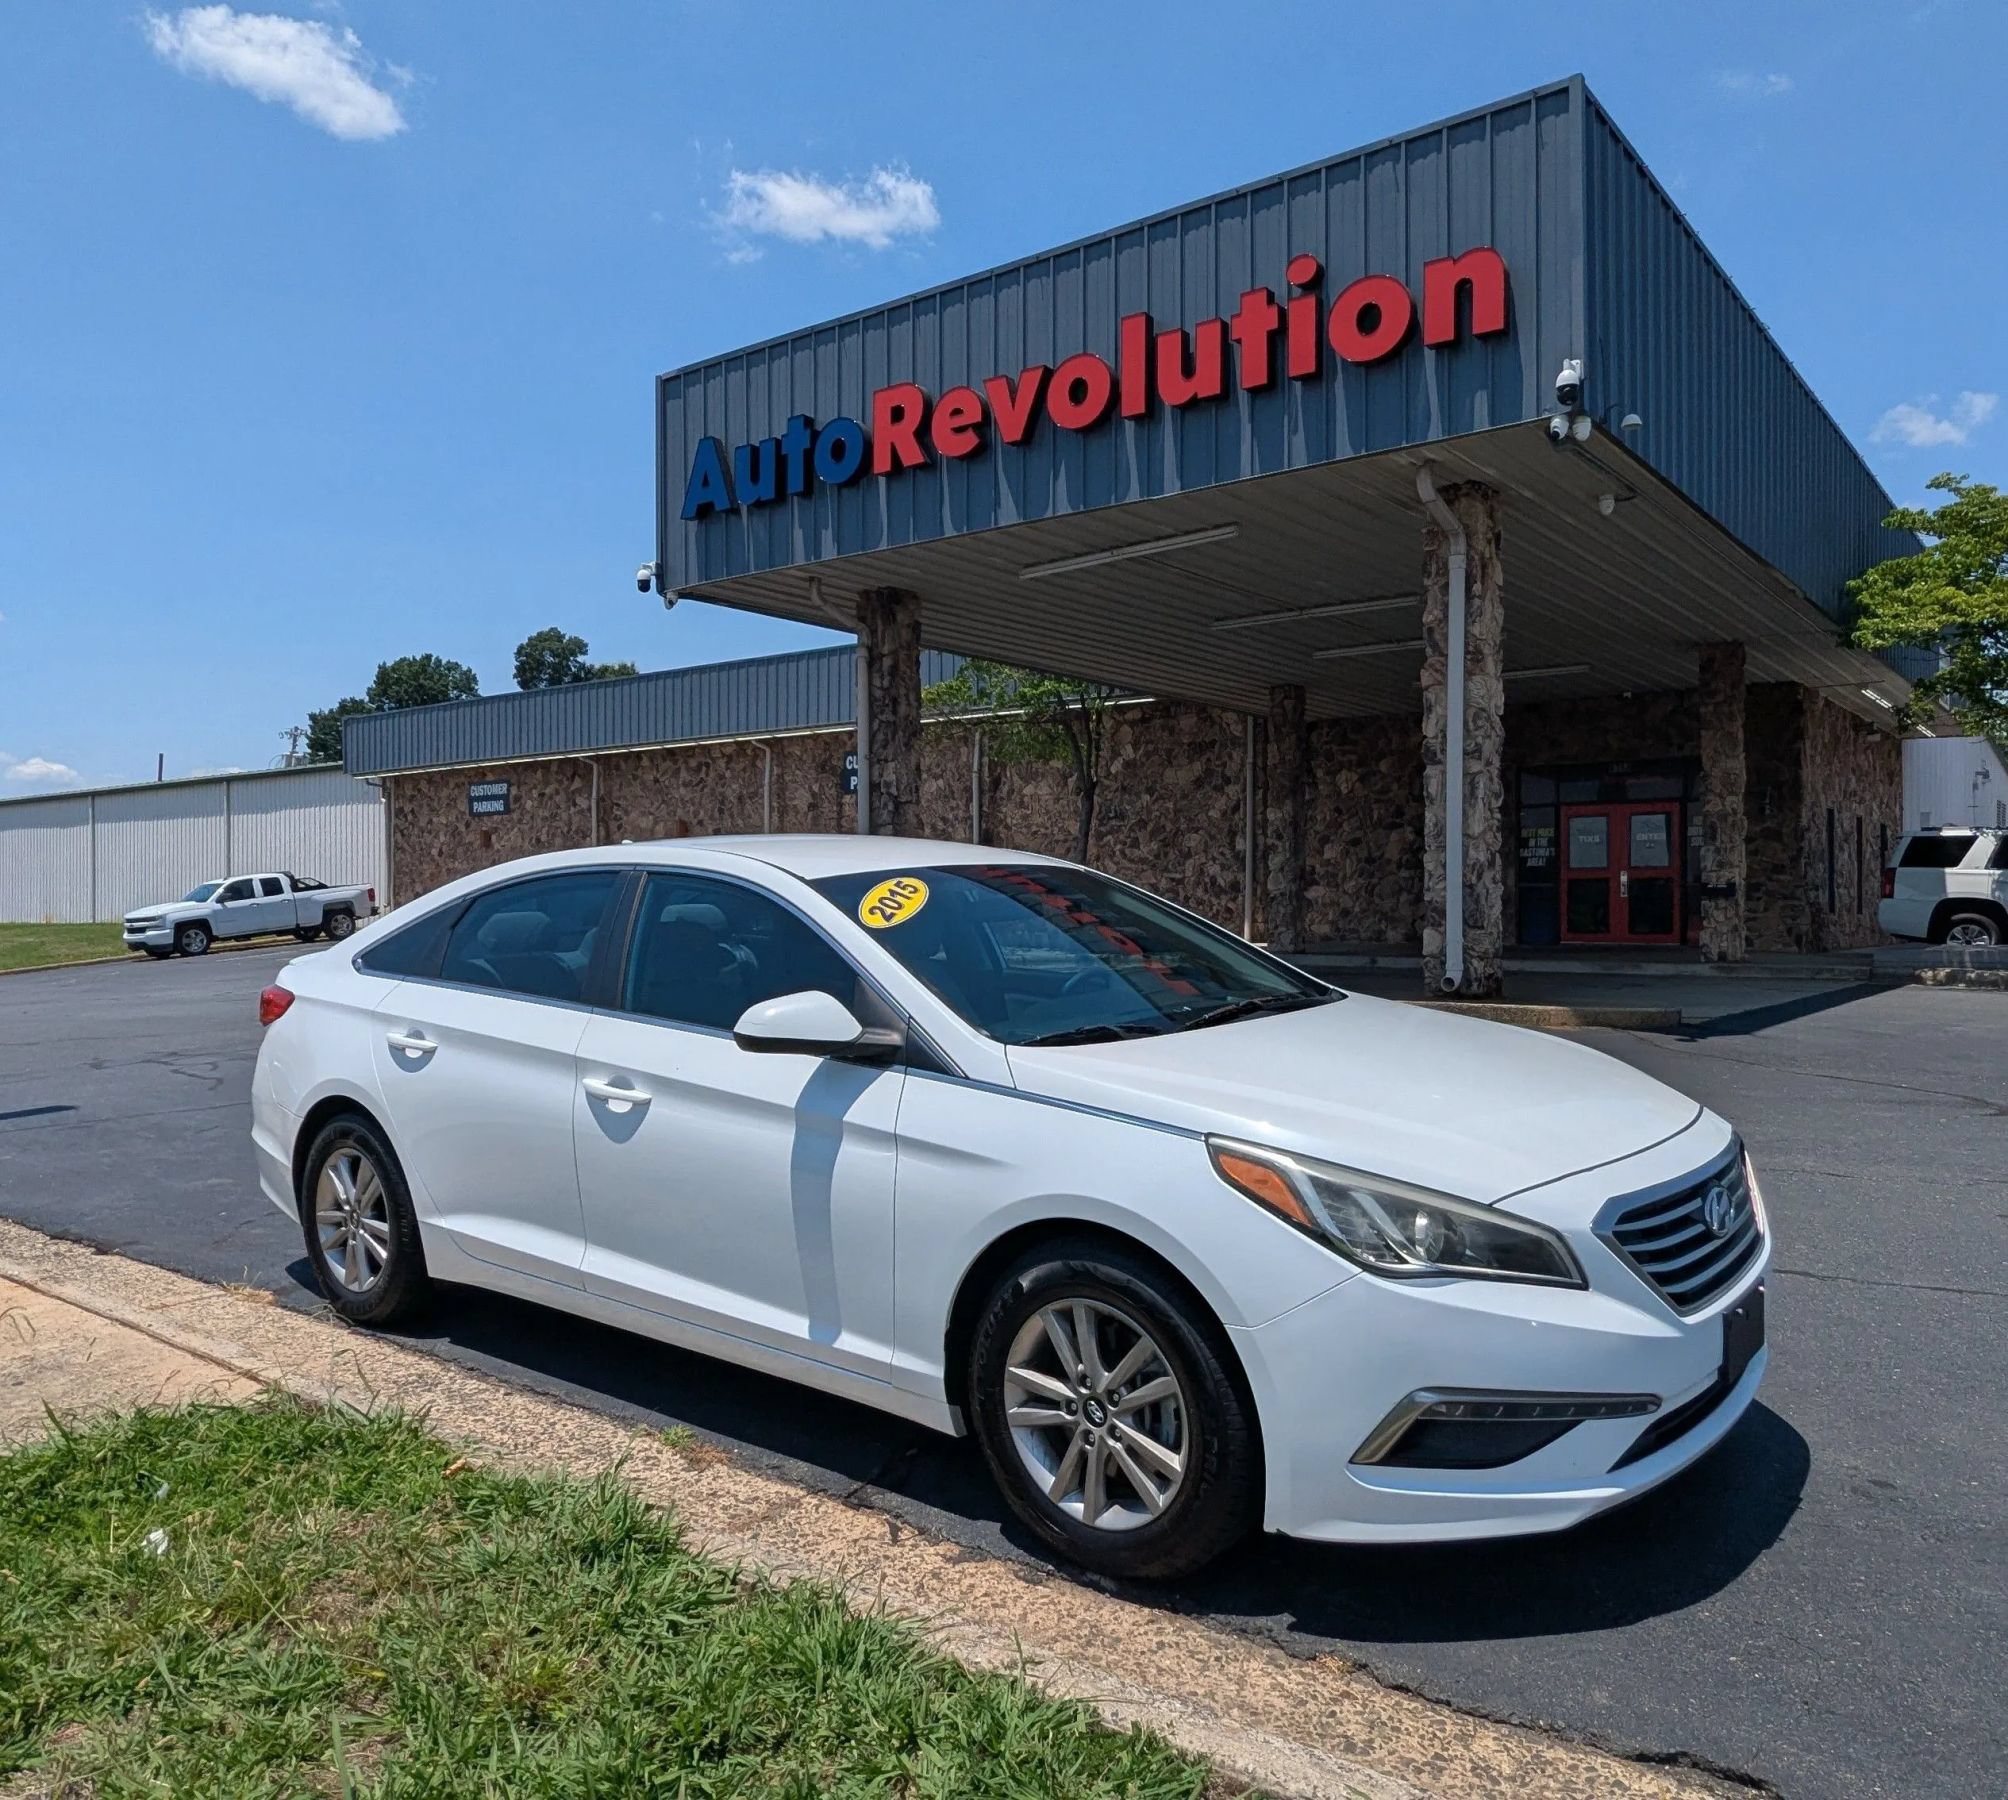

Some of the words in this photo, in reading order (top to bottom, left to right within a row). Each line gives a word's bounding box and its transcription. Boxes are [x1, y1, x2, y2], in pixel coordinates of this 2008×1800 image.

[471, 783, 508, 796] CUSTOMER
[473, 800, 504, 813] PARKING
[868, 880, 919, 923] 2015
